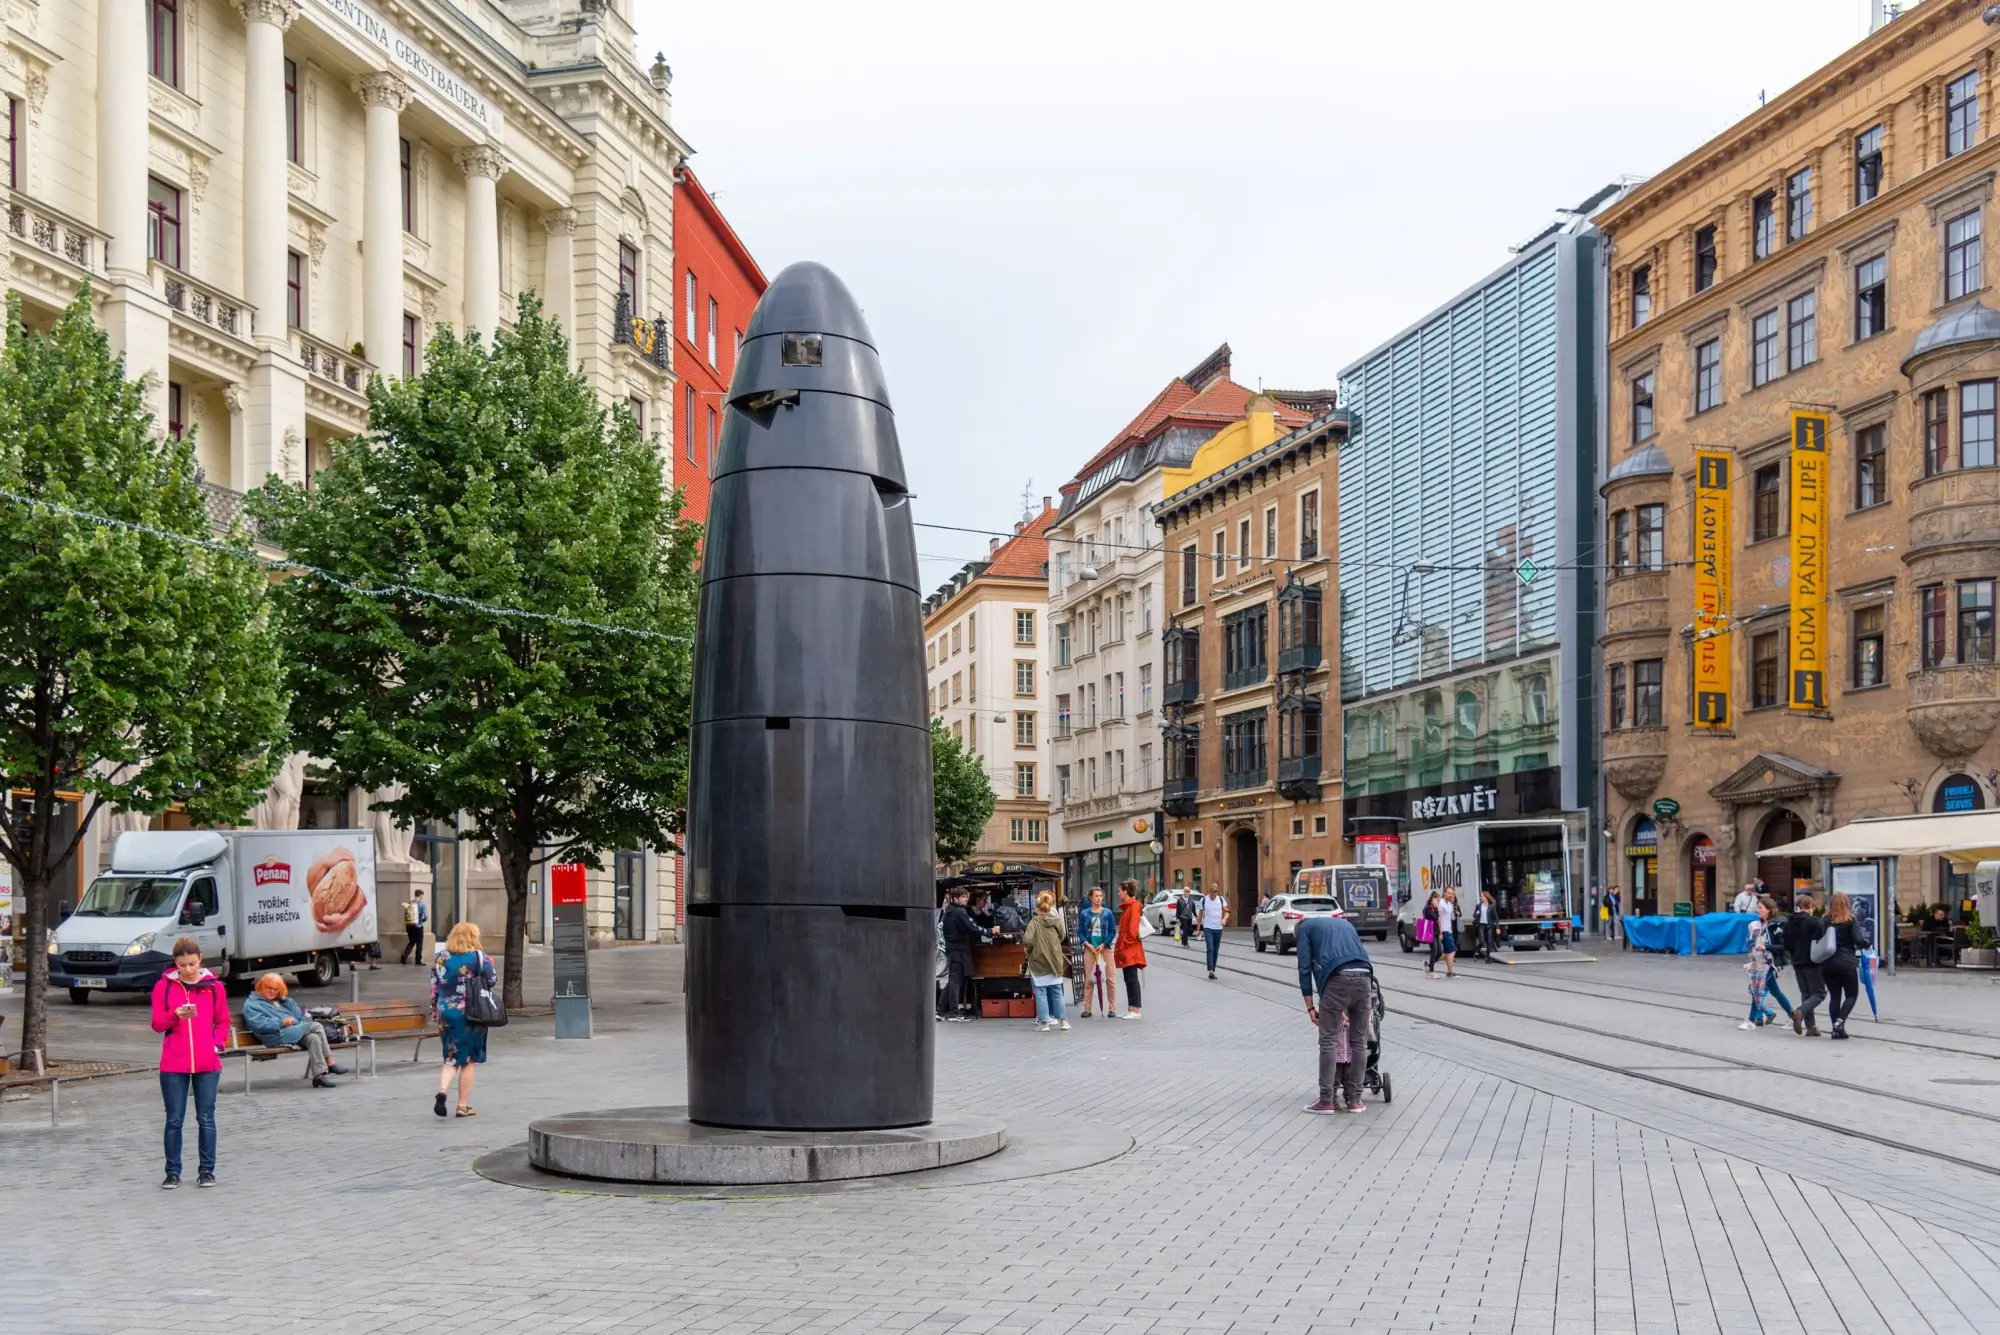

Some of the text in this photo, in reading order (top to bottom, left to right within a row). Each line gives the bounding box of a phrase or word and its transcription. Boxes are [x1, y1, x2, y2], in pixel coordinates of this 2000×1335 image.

[395, 39, 487, 122] GERSTBAUERA
[1796, 459, 1817, 661] DŮM PÁNŮ Z LIPÉ
[1703, 504, 1717, 675] STUENT AGENCY
[1944, 785, 1974, 797] PRODEJ
[1945, 799, 1973, 810] SERVIS
[1625, 845, 1657, 856] EXCHANGE
[256, 868, 289, 883] Penam
[1430, 851, 1462, 889] kofola
[258, 896, 290, 909] TVOŘÍME
[247, 910, 300, 925] PŘÍBĚH PEČIVA
